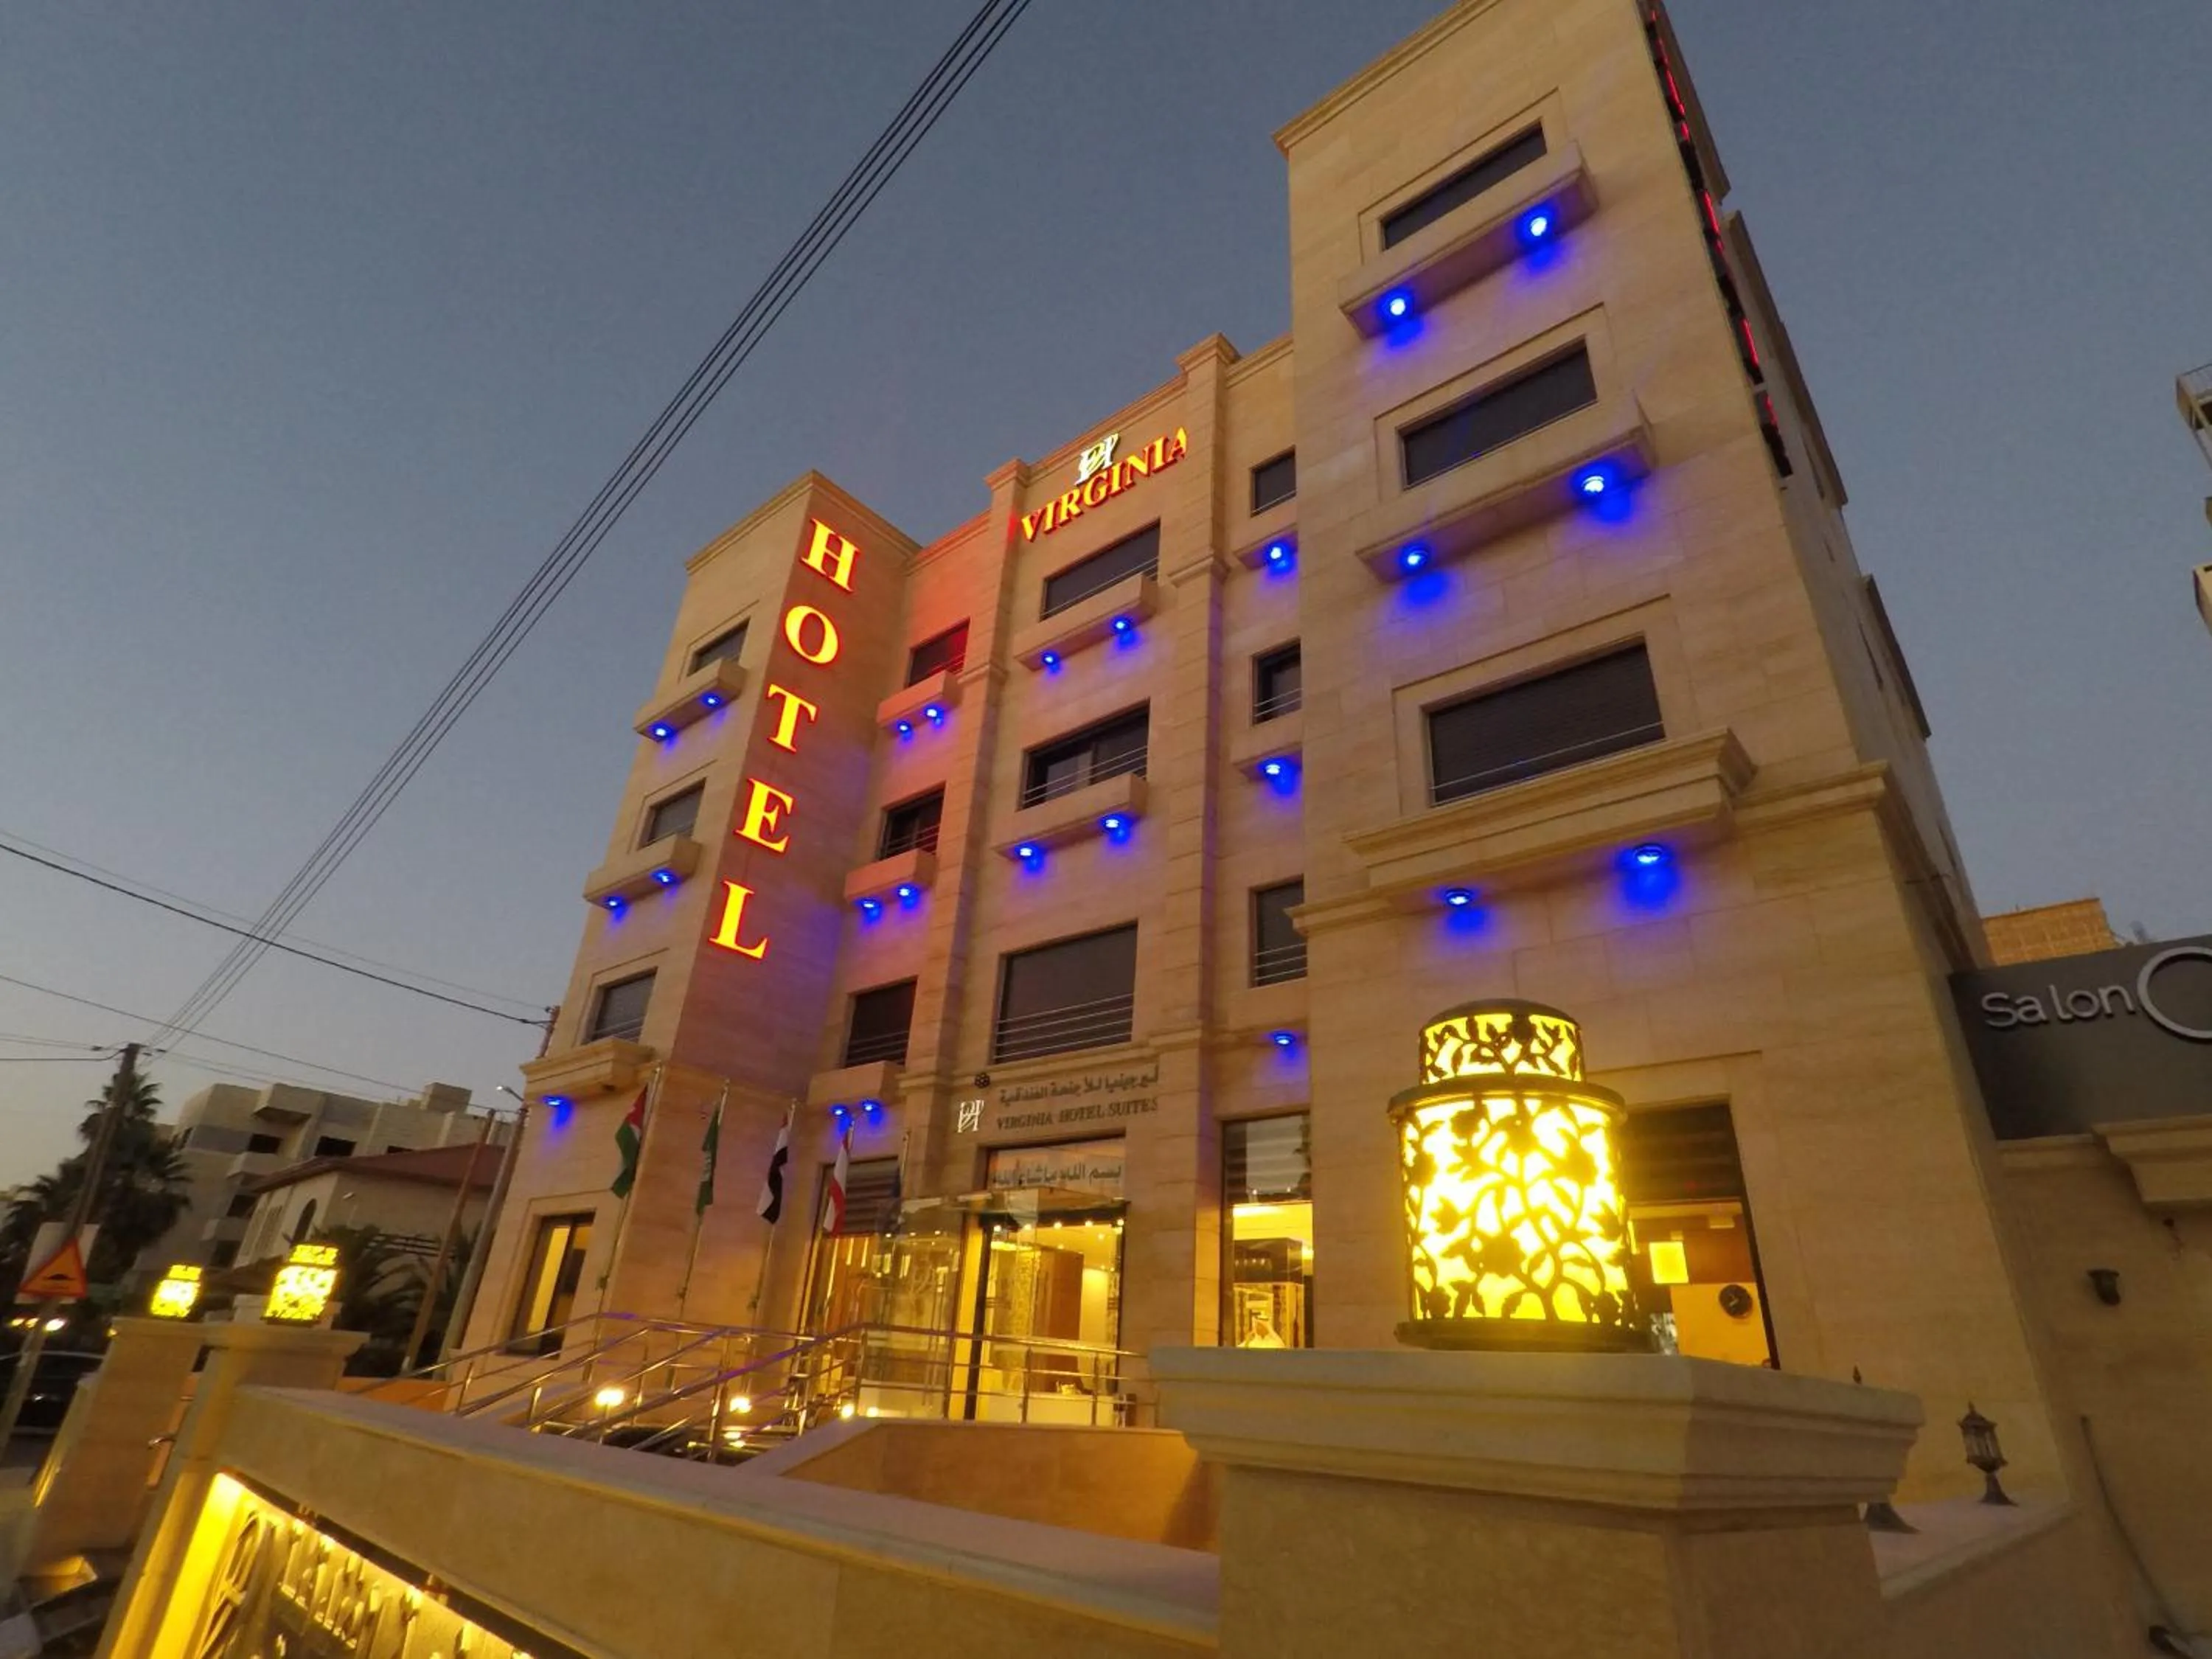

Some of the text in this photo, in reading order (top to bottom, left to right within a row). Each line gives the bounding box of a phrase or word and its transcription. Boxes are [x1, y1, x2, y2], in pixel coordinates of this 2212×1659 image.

[1021, 426, 1189, 543] VIRGINIA
[709, 518, 860, 961] HOTEL
[1981, 984, 2135, 1028] Salon
[998, 1110, 1053, 1130] VIRGINIA
[1058, 1104, 1105, 1123] HOTEL
[1108, 1097, 1158, 1117] SUITES
